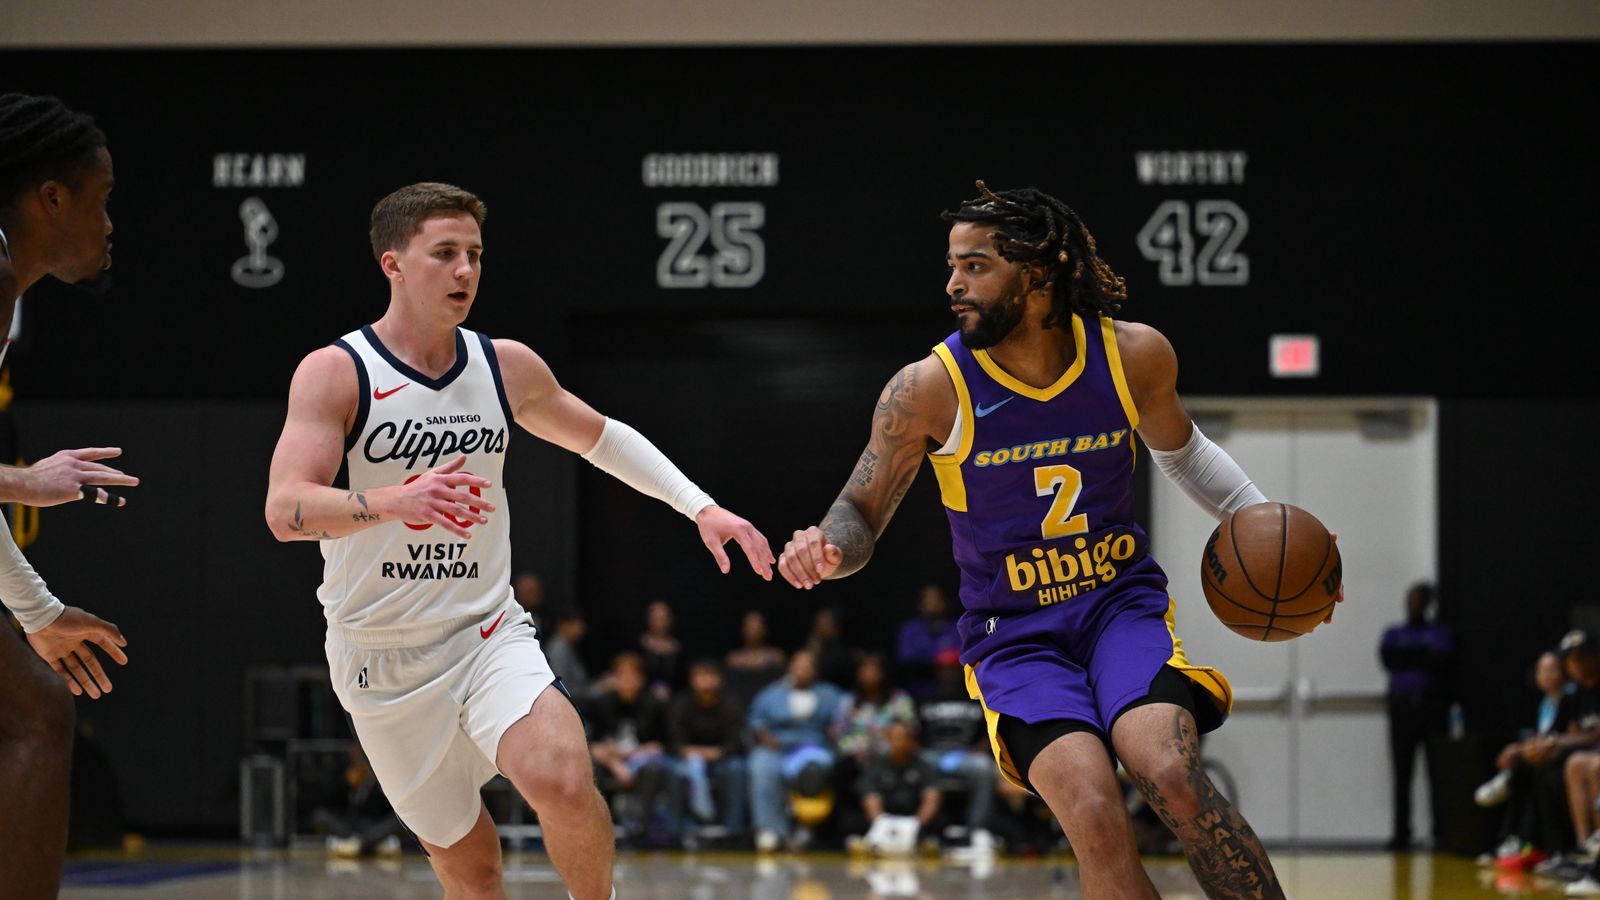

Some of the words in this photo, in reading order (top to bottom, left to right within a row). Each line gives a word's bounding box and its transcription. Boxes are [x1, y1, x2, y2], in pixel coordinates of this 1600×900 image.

[657, 202, 766, 288] 25
[1136, 200, 1249, 286] 42
[364, 419, 505, 470] Clippers
[425, 415, 448, 425] SAN
[449, 414, 481, 424] DIEGO
[973, 437, 1071, 467] SOUTH
[1072, 429, 1128, 453] BAY
[1033, 464, 1090, 540] 2
[381, 562, 479, 580] RWANDA
[407, 543, 467, 561] VISIT
[1005, 533, 1136, 591] bibigo
